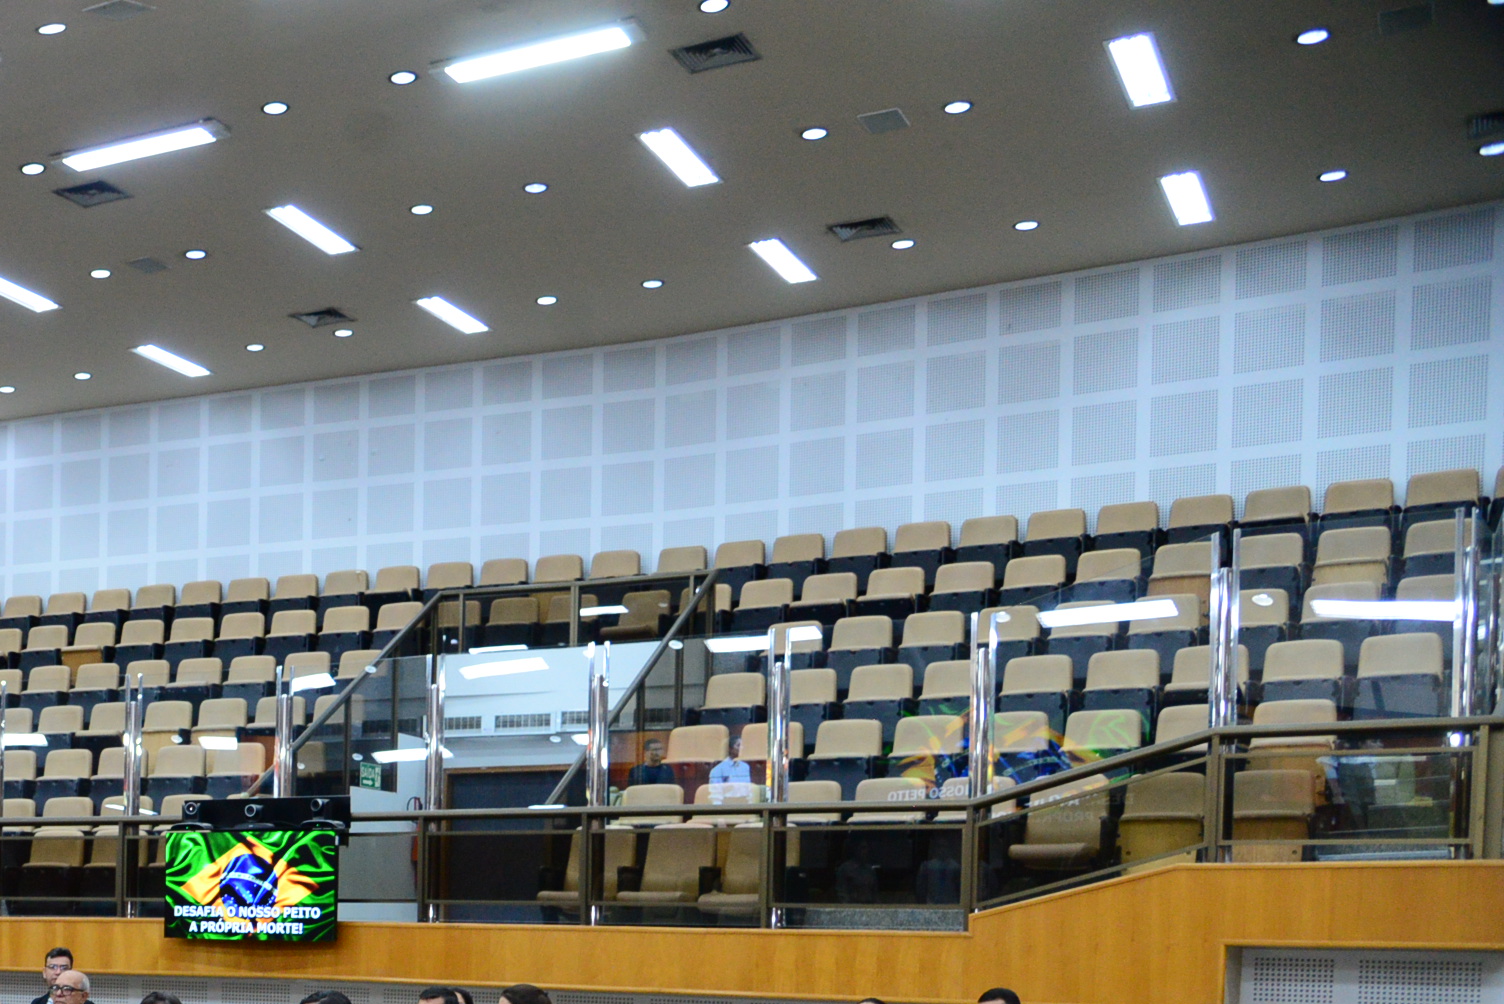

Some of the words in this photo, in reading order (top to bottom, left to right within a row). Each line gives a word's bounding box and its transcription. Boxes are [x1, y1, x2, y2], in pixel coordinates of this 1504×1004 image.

[174, 905, 224, 917] DESAFIA
[227, 906, 236, 918] O
[238, 906, 281, 919] NOSSO
[283, 907, 321, 919] PEITO
[189, 921, 198, 932] A
[200, 918, 254, 933] PRÓPRIA
[256, 922, 303, 934] MORTE!
